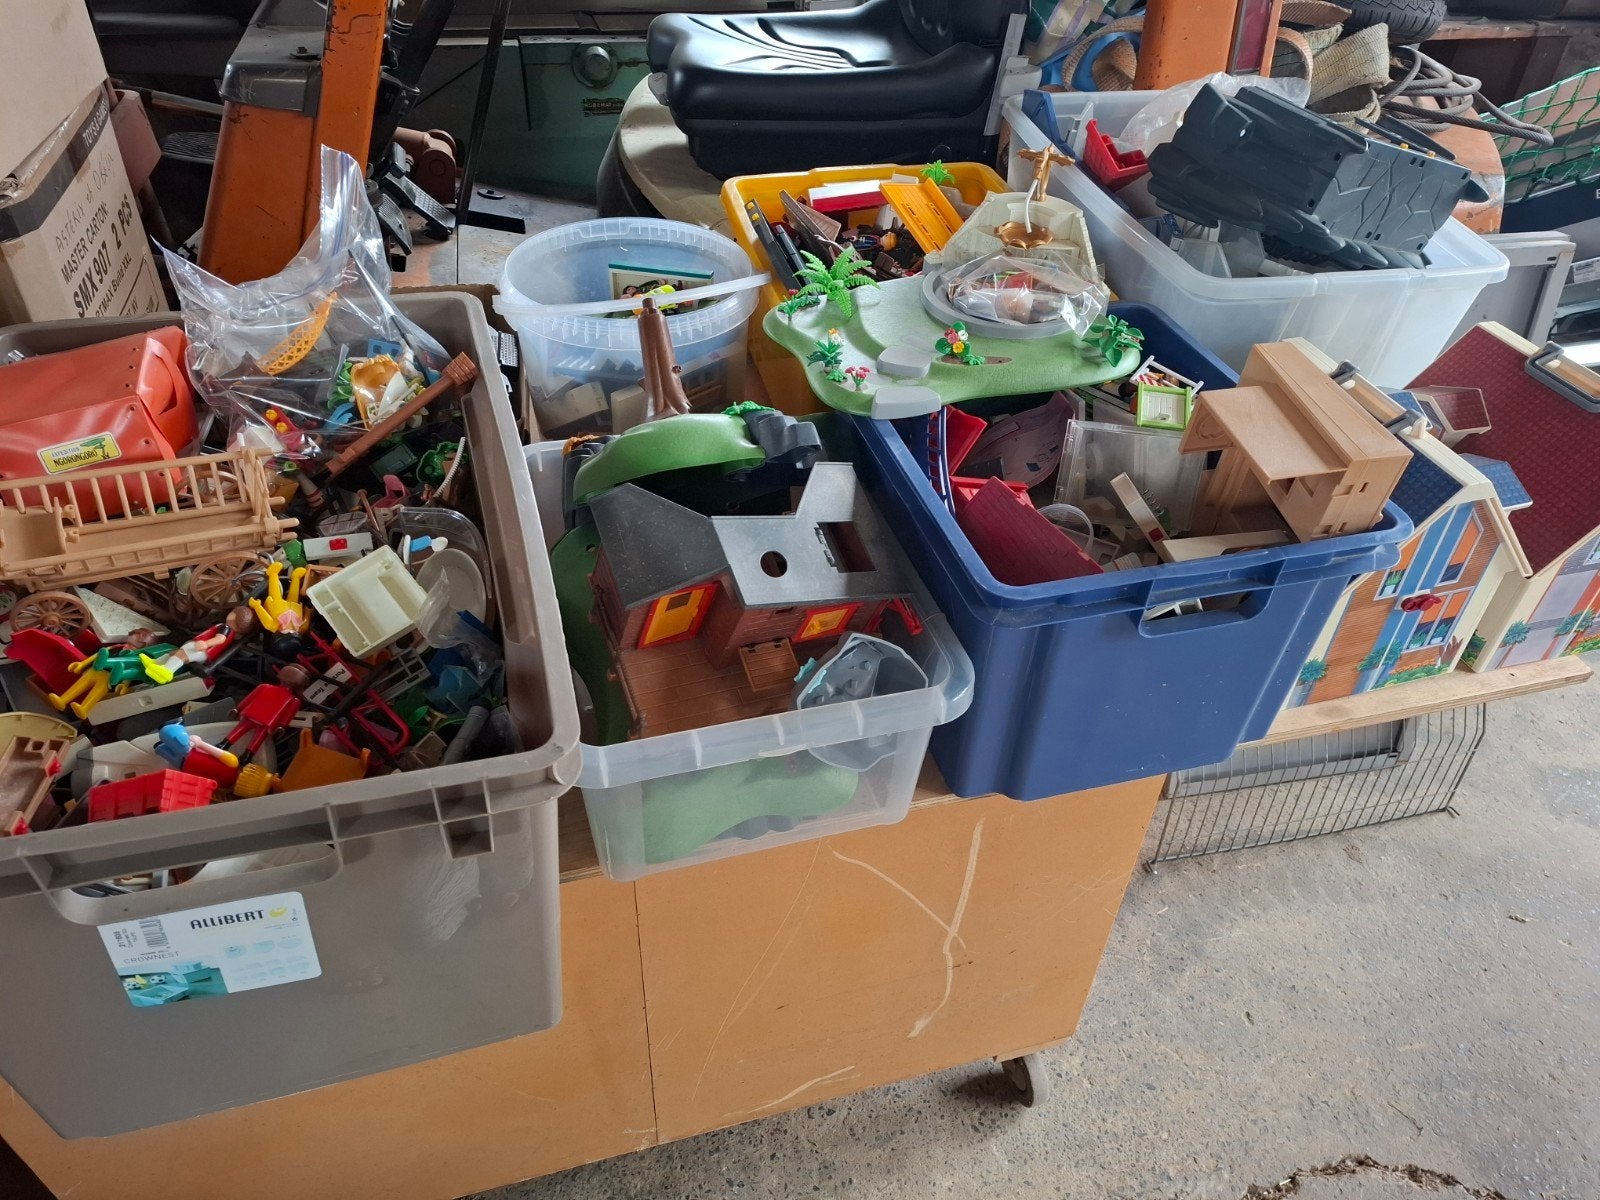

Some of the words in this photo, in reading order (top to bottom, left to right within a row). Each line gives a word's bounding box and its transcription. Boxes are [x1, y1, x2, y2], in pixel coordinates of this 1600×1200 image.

[61, 237, 89, 284] MASTER
[73, 266, 99, 318] SMX
[92, 240, 111, 285] 907
[111, 222, 122, 250] 2
[117, 193, 132, 236] PCS
[111, 264, 125, 292] Build
[121, 252, 132, 270] XXL
[53, 450, 98, 466] NGORONGORO
[123, 951, 180, 964] CROWNEST
